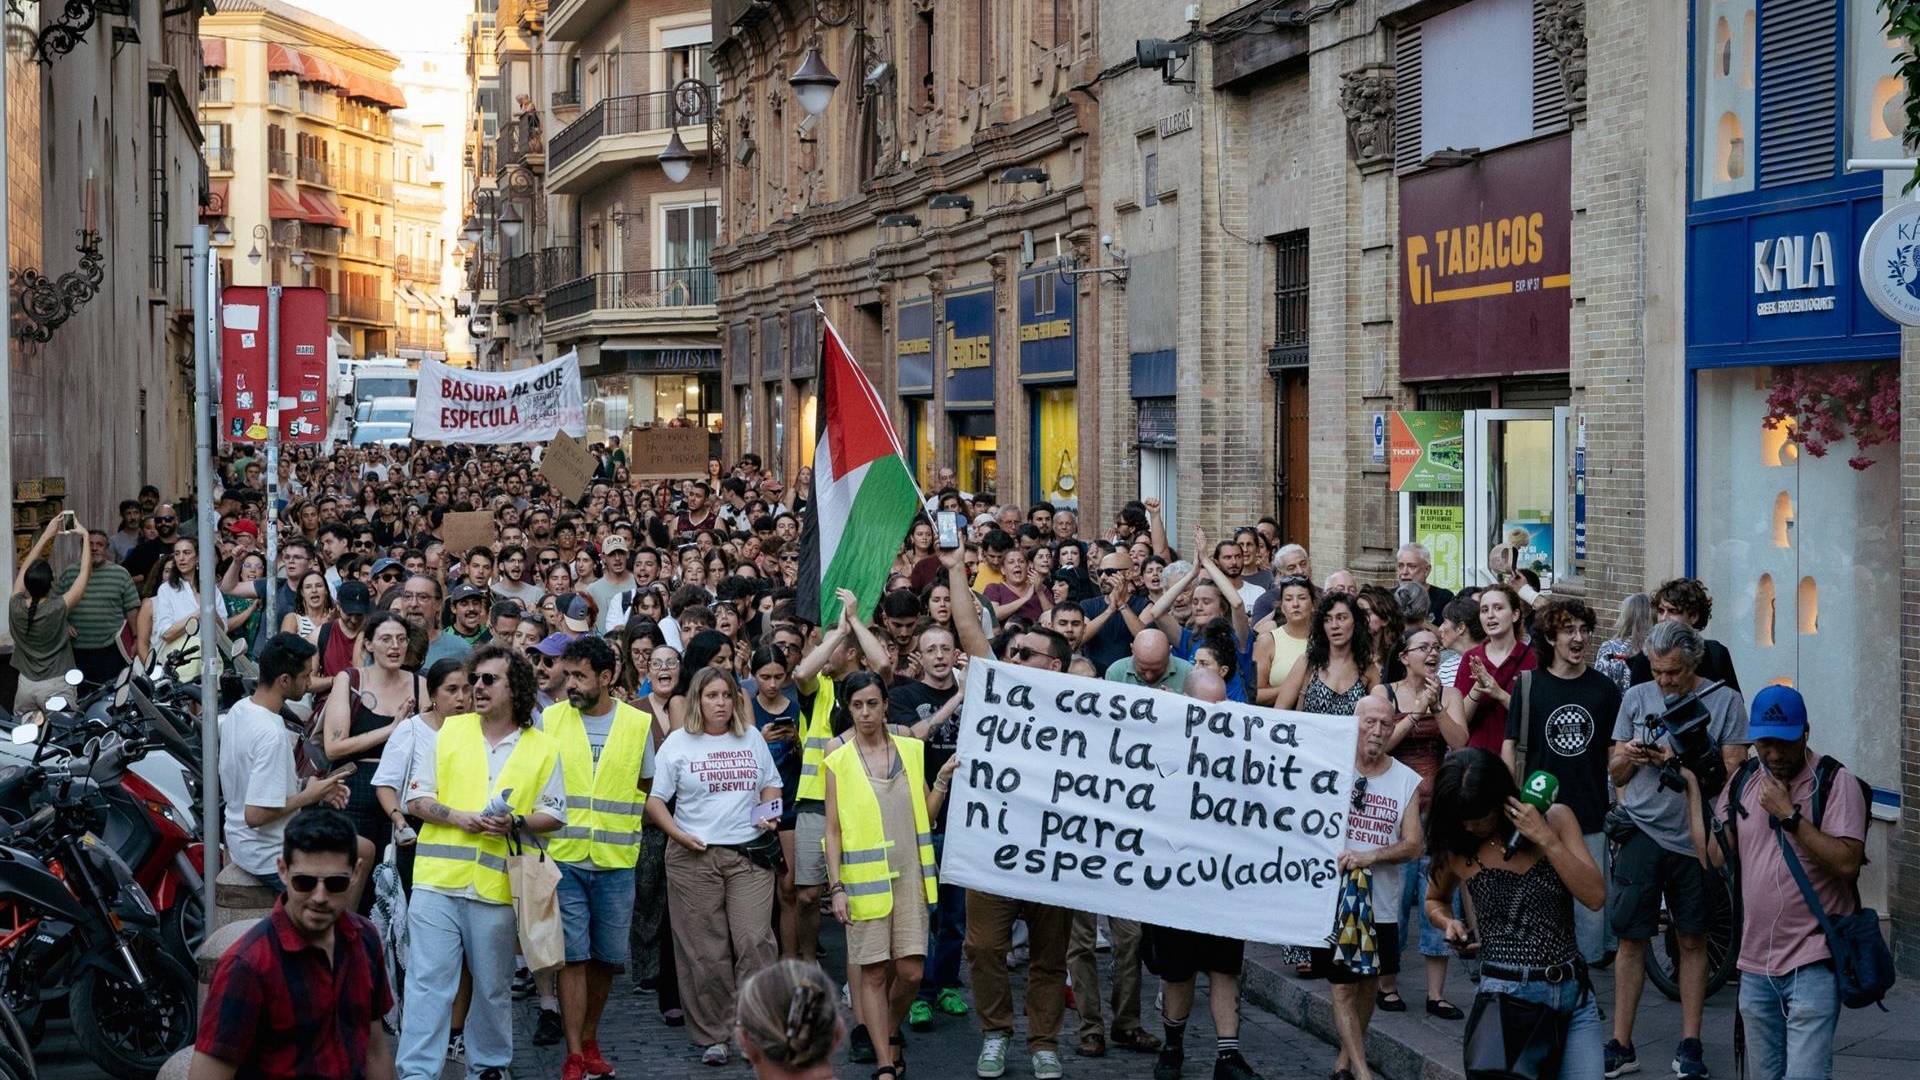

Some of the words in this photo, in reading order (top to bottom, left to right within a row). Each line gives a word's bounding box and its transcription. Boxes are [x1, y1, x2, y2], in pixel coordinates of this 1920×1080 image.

[1160, 109, 1190, 136] VILLEGAS
[1436, 212, 1543, 277] TABACOS
[1755, 231, 1835, 294] KALA
[1757, 302, 1776, 316] GREEK
[441, 378, 507, 401] BASURA
[511, 381, 529, 399] AL
[533, 367, 563, 392] QUE
[440, 401, 519, 429] ESPECULÁ
[1420, 508, 1444, 516] VIERNES
[1421, 533, 1463, 588] 13
[985, 668, 1035, 711] La
[1055, 689, 1158, 724] casa
[1185, 703, 1299, 748] para
[692, 762, 704, 772] DE
[705, 759, 757, 770] INQUILINAS
[707, 750, 753, 759] SINDICATO
[976, 714, 1087, 759] quien
[1109, 728, 1155, 771] la
[1187, 736, 1339, 795] habita
[700, 772, 705, 782] E
[707, 769, 758, 781] INQUILINOS
[709, 783, 720, 793] DE
[722, 781, 756, 793] SEVILLA
[1531, 775, 1547, 791] 6
[969, 758, 1021, 794] no
[1051, 769, 1157, 812] para
[1190, 781, 1343, 838] bancos
[1351, 790, 1398, 809] SDICATO
[965, 801, 1010, 835] ni
[1040, 811, 1145, 856] para
[1355, 831, 1390, 846] SEVILLA
[994, 846, 1337, 891] especuculadores
